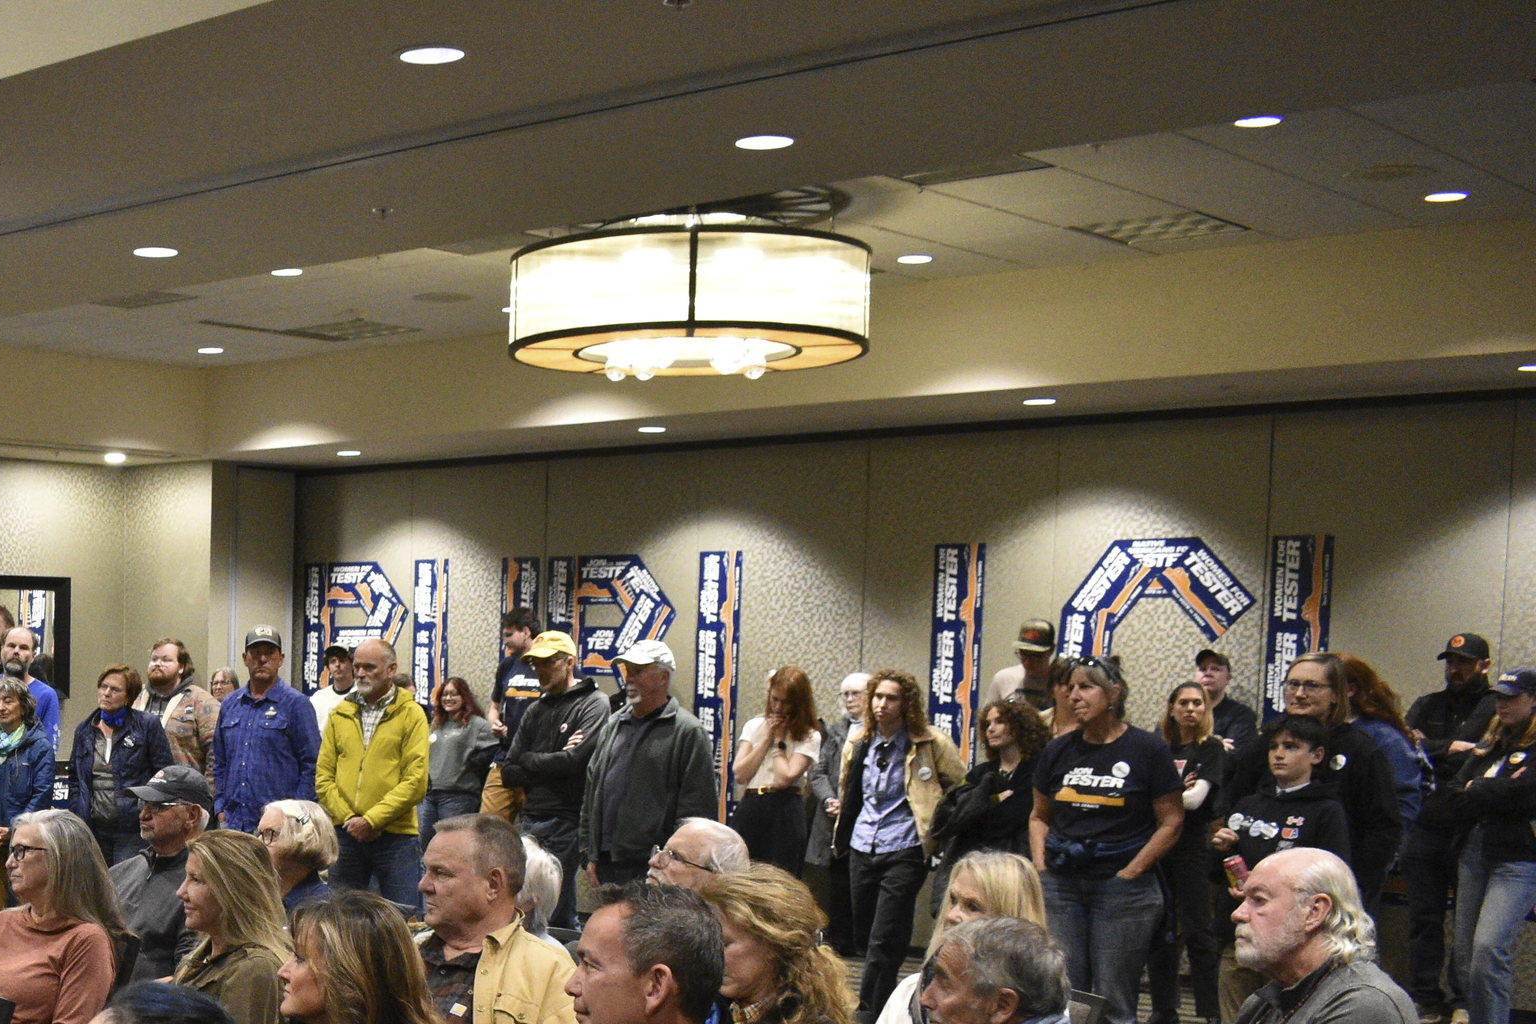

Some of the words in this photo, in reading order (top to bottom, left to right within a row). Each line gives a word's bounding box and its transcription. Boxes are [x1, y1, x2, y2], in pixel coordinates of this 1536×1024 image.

[586, 559, 607, 567] JON
[938, 548, 946, 570] FOR
[1132, 540, 1167, 548] NATIVE
[1176, 545, 1189, 554] FO
[1277, 540, 1286, 564] FOR
[310, 567, 319, 625] TESTER
[520, 561, 531, 608] TEST
[556, 560, 567, 623] TESTER
[705, 554, 720, 624] TESTER
[936, 572, 946, 618] WOMEN
[943, 548, 958, 622] TESTER
[1183, 551, 1244, 617] TESTER
[1197, 548, 1233, 588] WOMEN
[1230, 585, 1250, 607] FOR
[1274, 567, 1285, 617] WOMEN
[1282, 540, 1301, 622] TESTER
[586, 637, 614, 650] TES
[592, 630, 614, 638] JON
[617, 597, 655, 655] TESTER
[698, 630, 707, 651] FOR
[1276, 632, 1284, 650] FOR
[309, 631, 318, 690] TESTER
[419, 647, 429, 705] TESTER
[697, 652, 705, 694] WOMEN
[703, 630, 717, 699] TESTER
[932, 667, 940, 697] JON
[939, 630, 955, 705] TESTER
[1266, 663, 1274, 698] NATIVE
[1062, 773, 1126, 789] TESTER
[1069, 767, 1094, 775] JON
